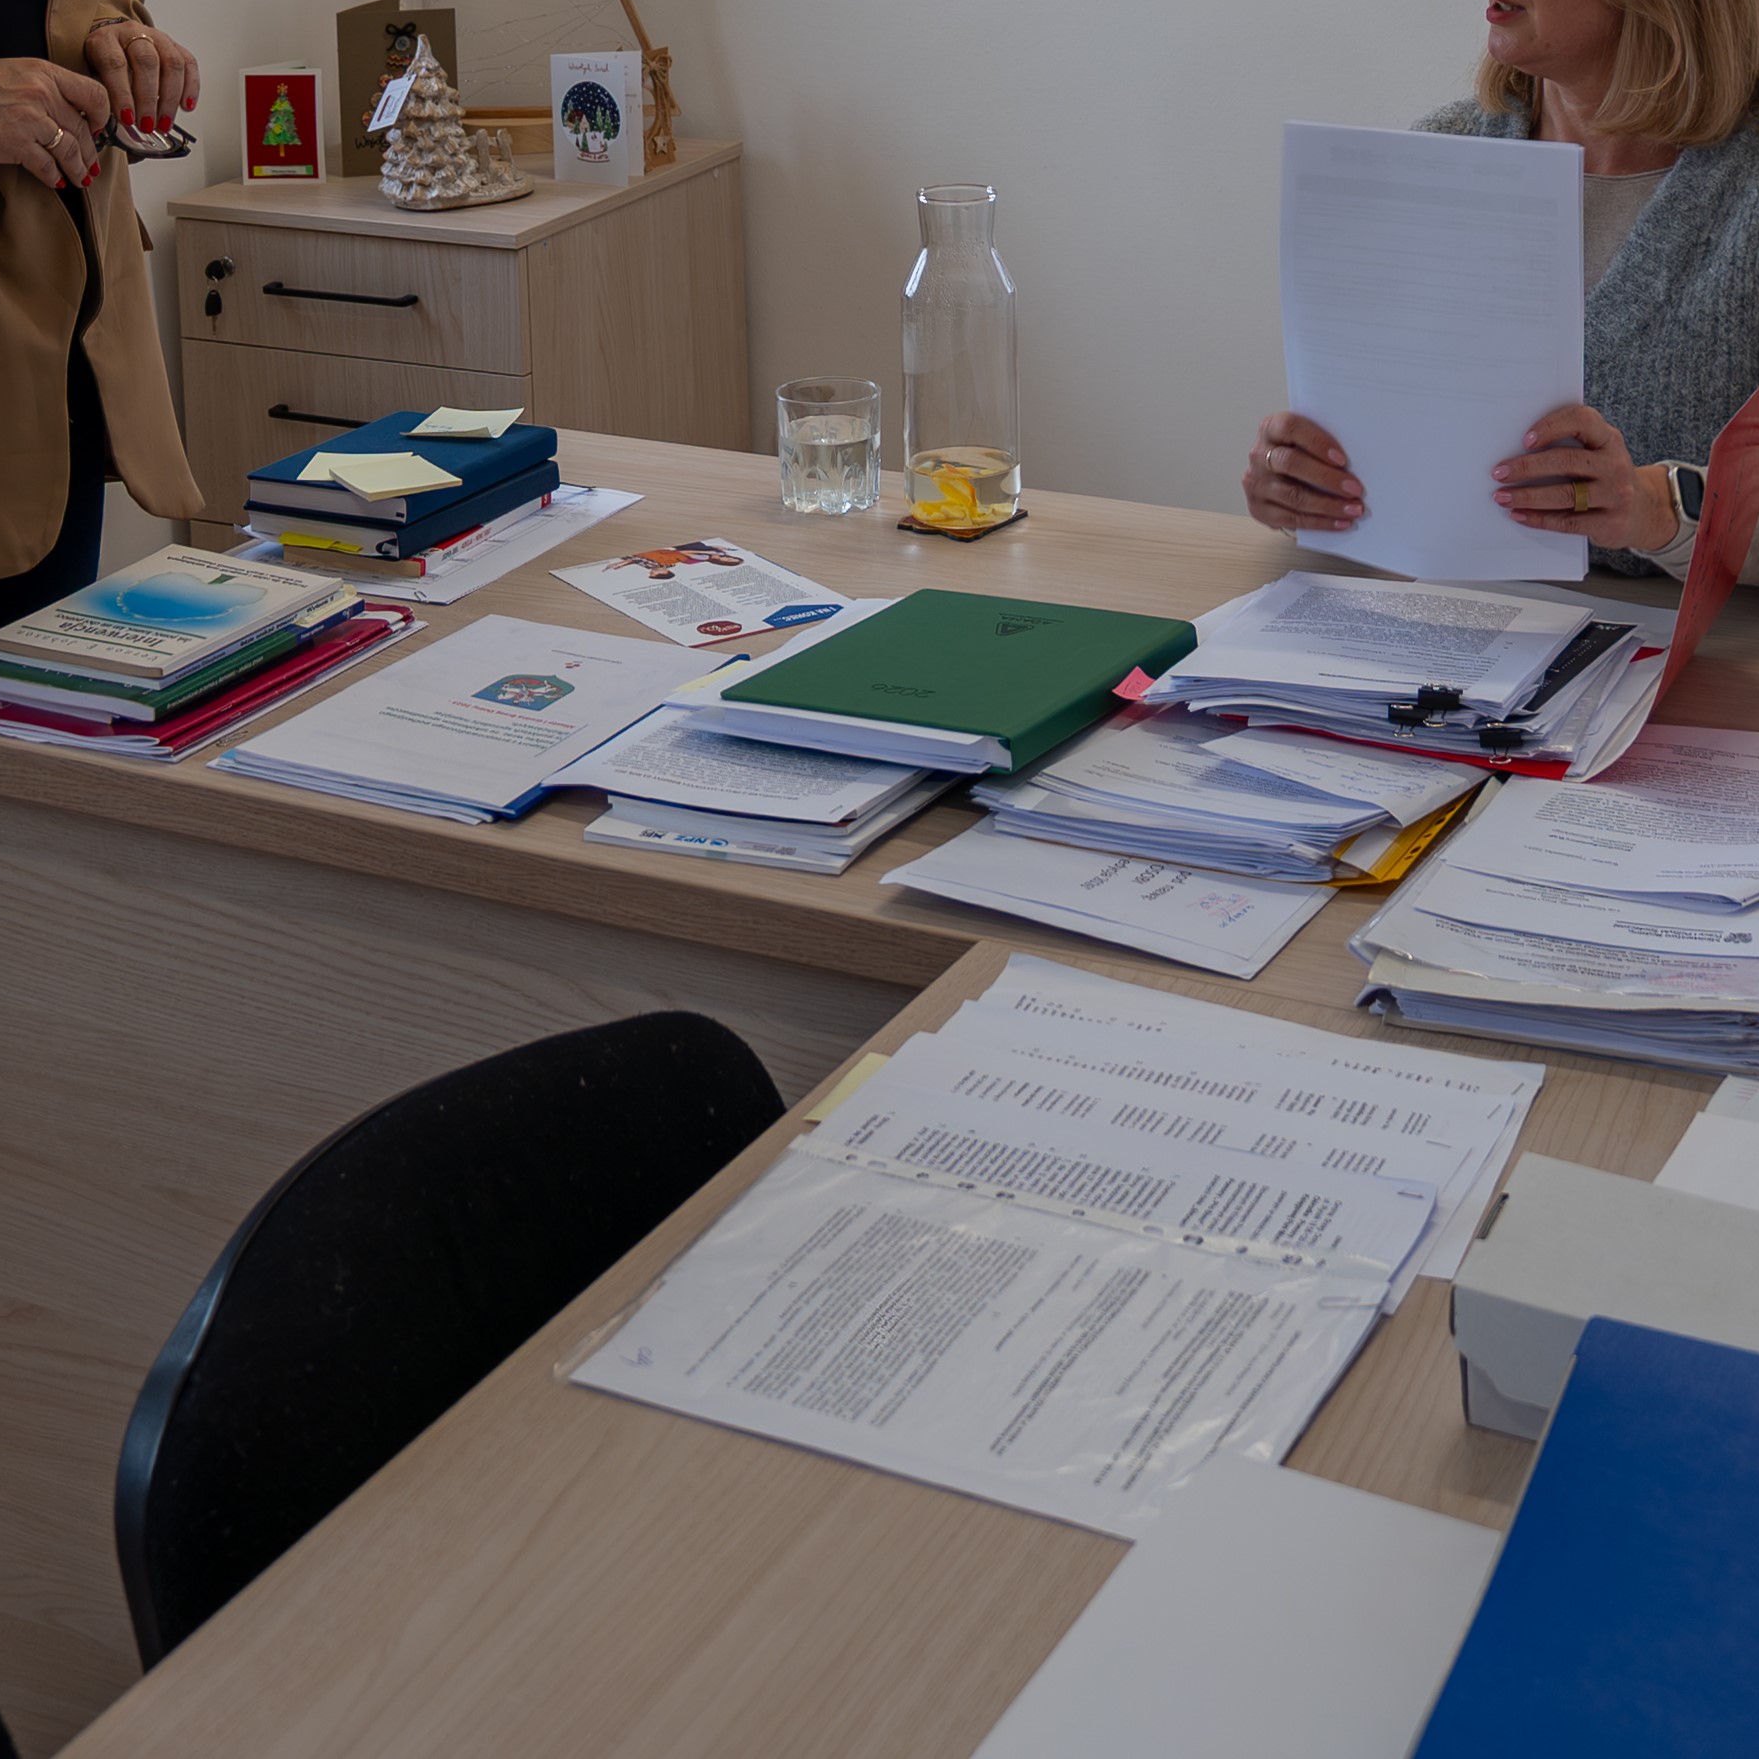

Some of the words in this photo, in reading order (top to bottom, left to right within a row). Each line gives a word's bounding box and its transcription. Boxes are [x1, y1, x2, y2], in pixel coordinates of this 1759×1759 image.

[814, 606, 830, 616] NA
[11, 629, 80, 645] Johnson
[52, 620, 167, 647] Interwencja
[100, 646, 163, 661] Vernon
[673, 833, 708, 845] NPZ
